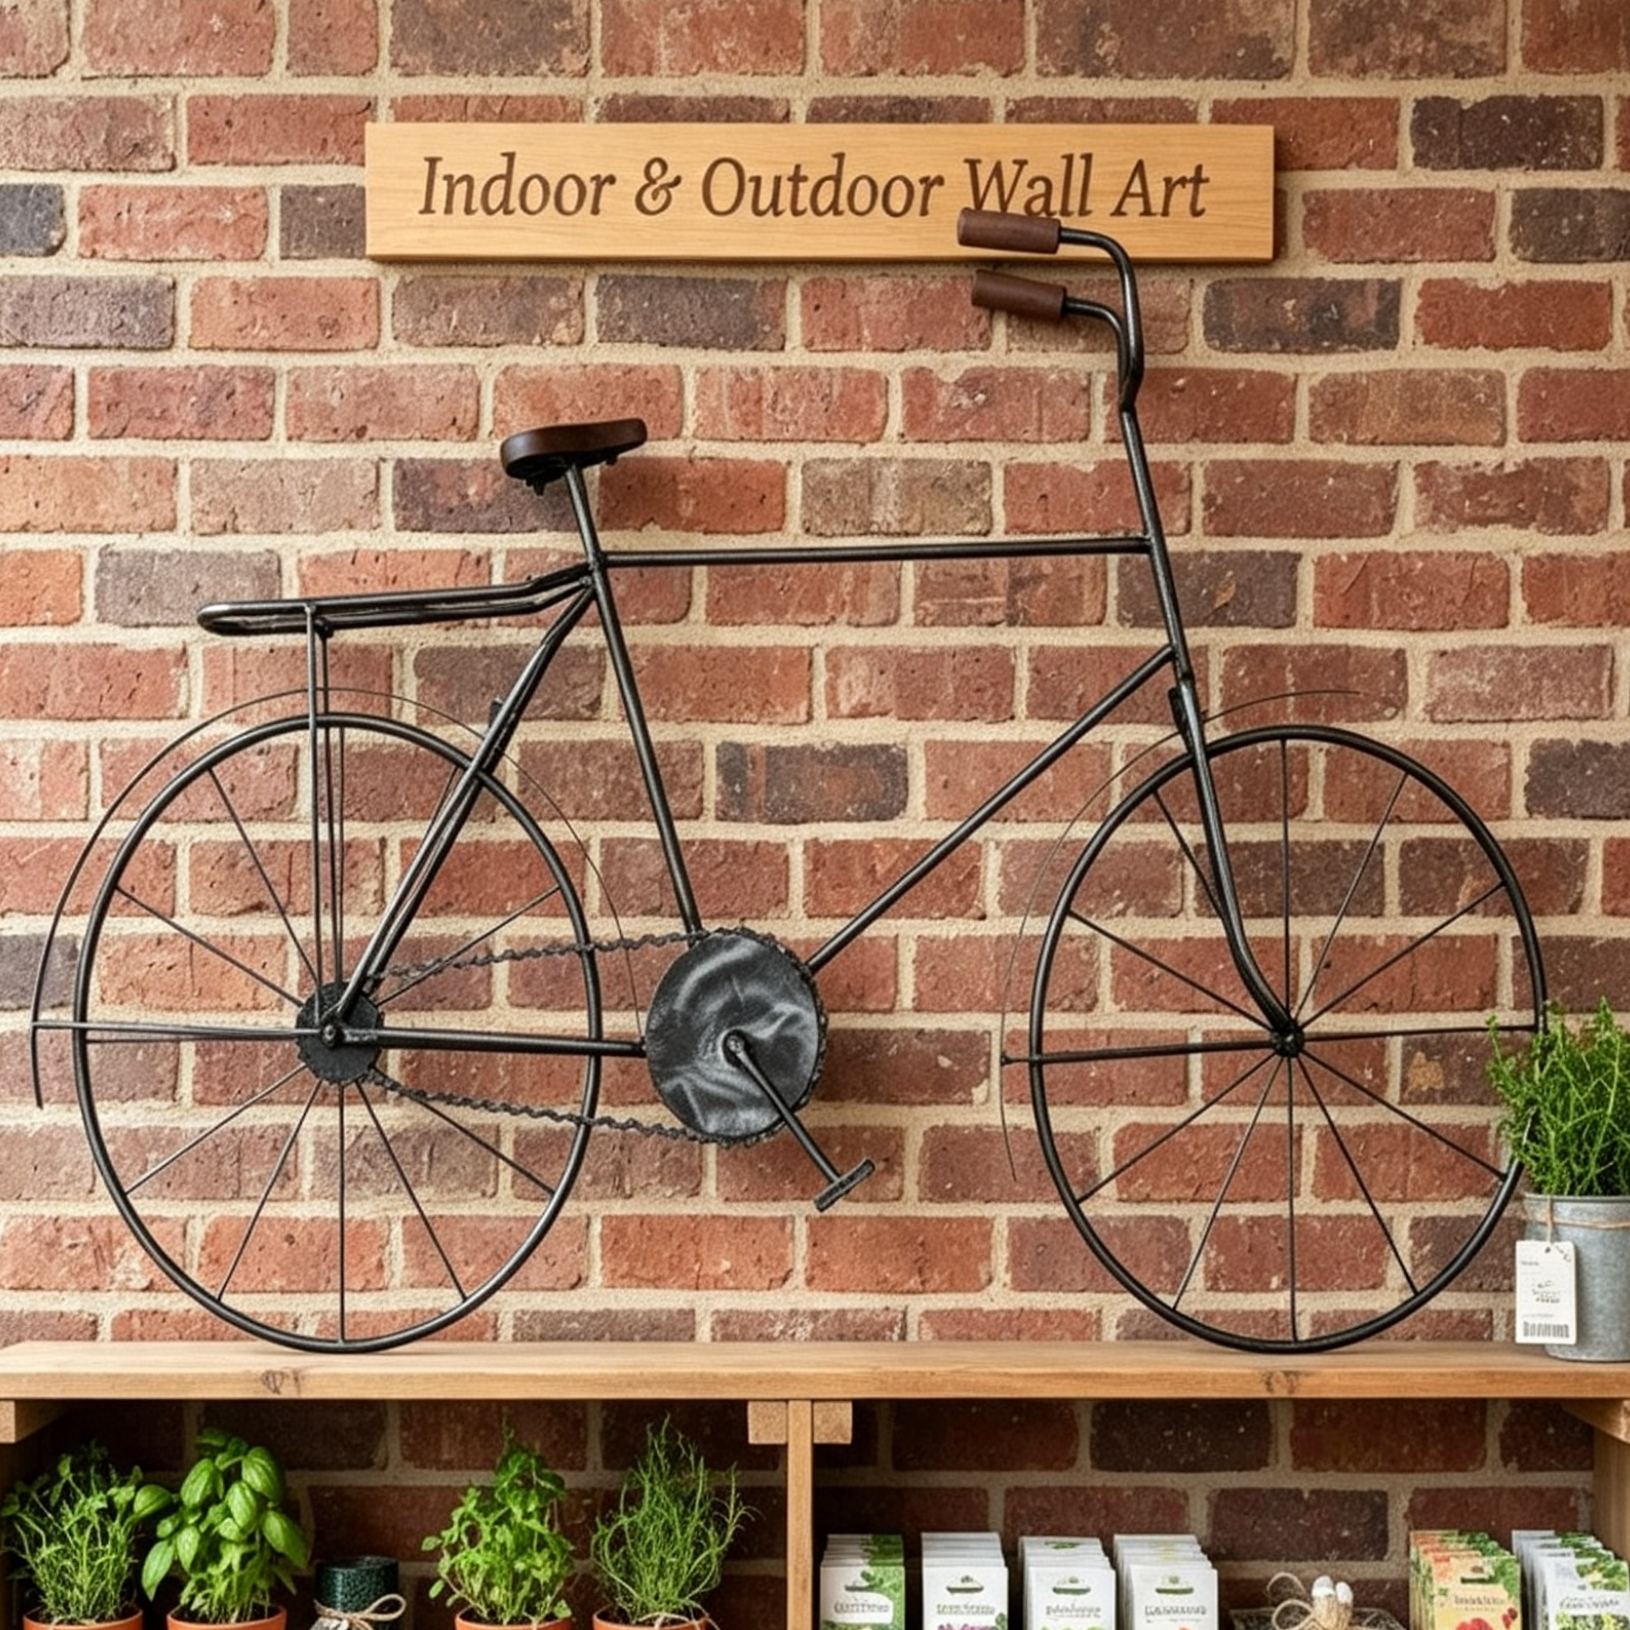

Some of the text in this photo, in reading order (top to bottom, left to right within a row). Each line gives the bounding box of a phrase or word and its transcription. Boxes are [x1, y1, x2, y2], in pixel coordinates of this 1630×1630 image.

[417, 151, 1210, 218] Indoor & Outdoor Wall Art
